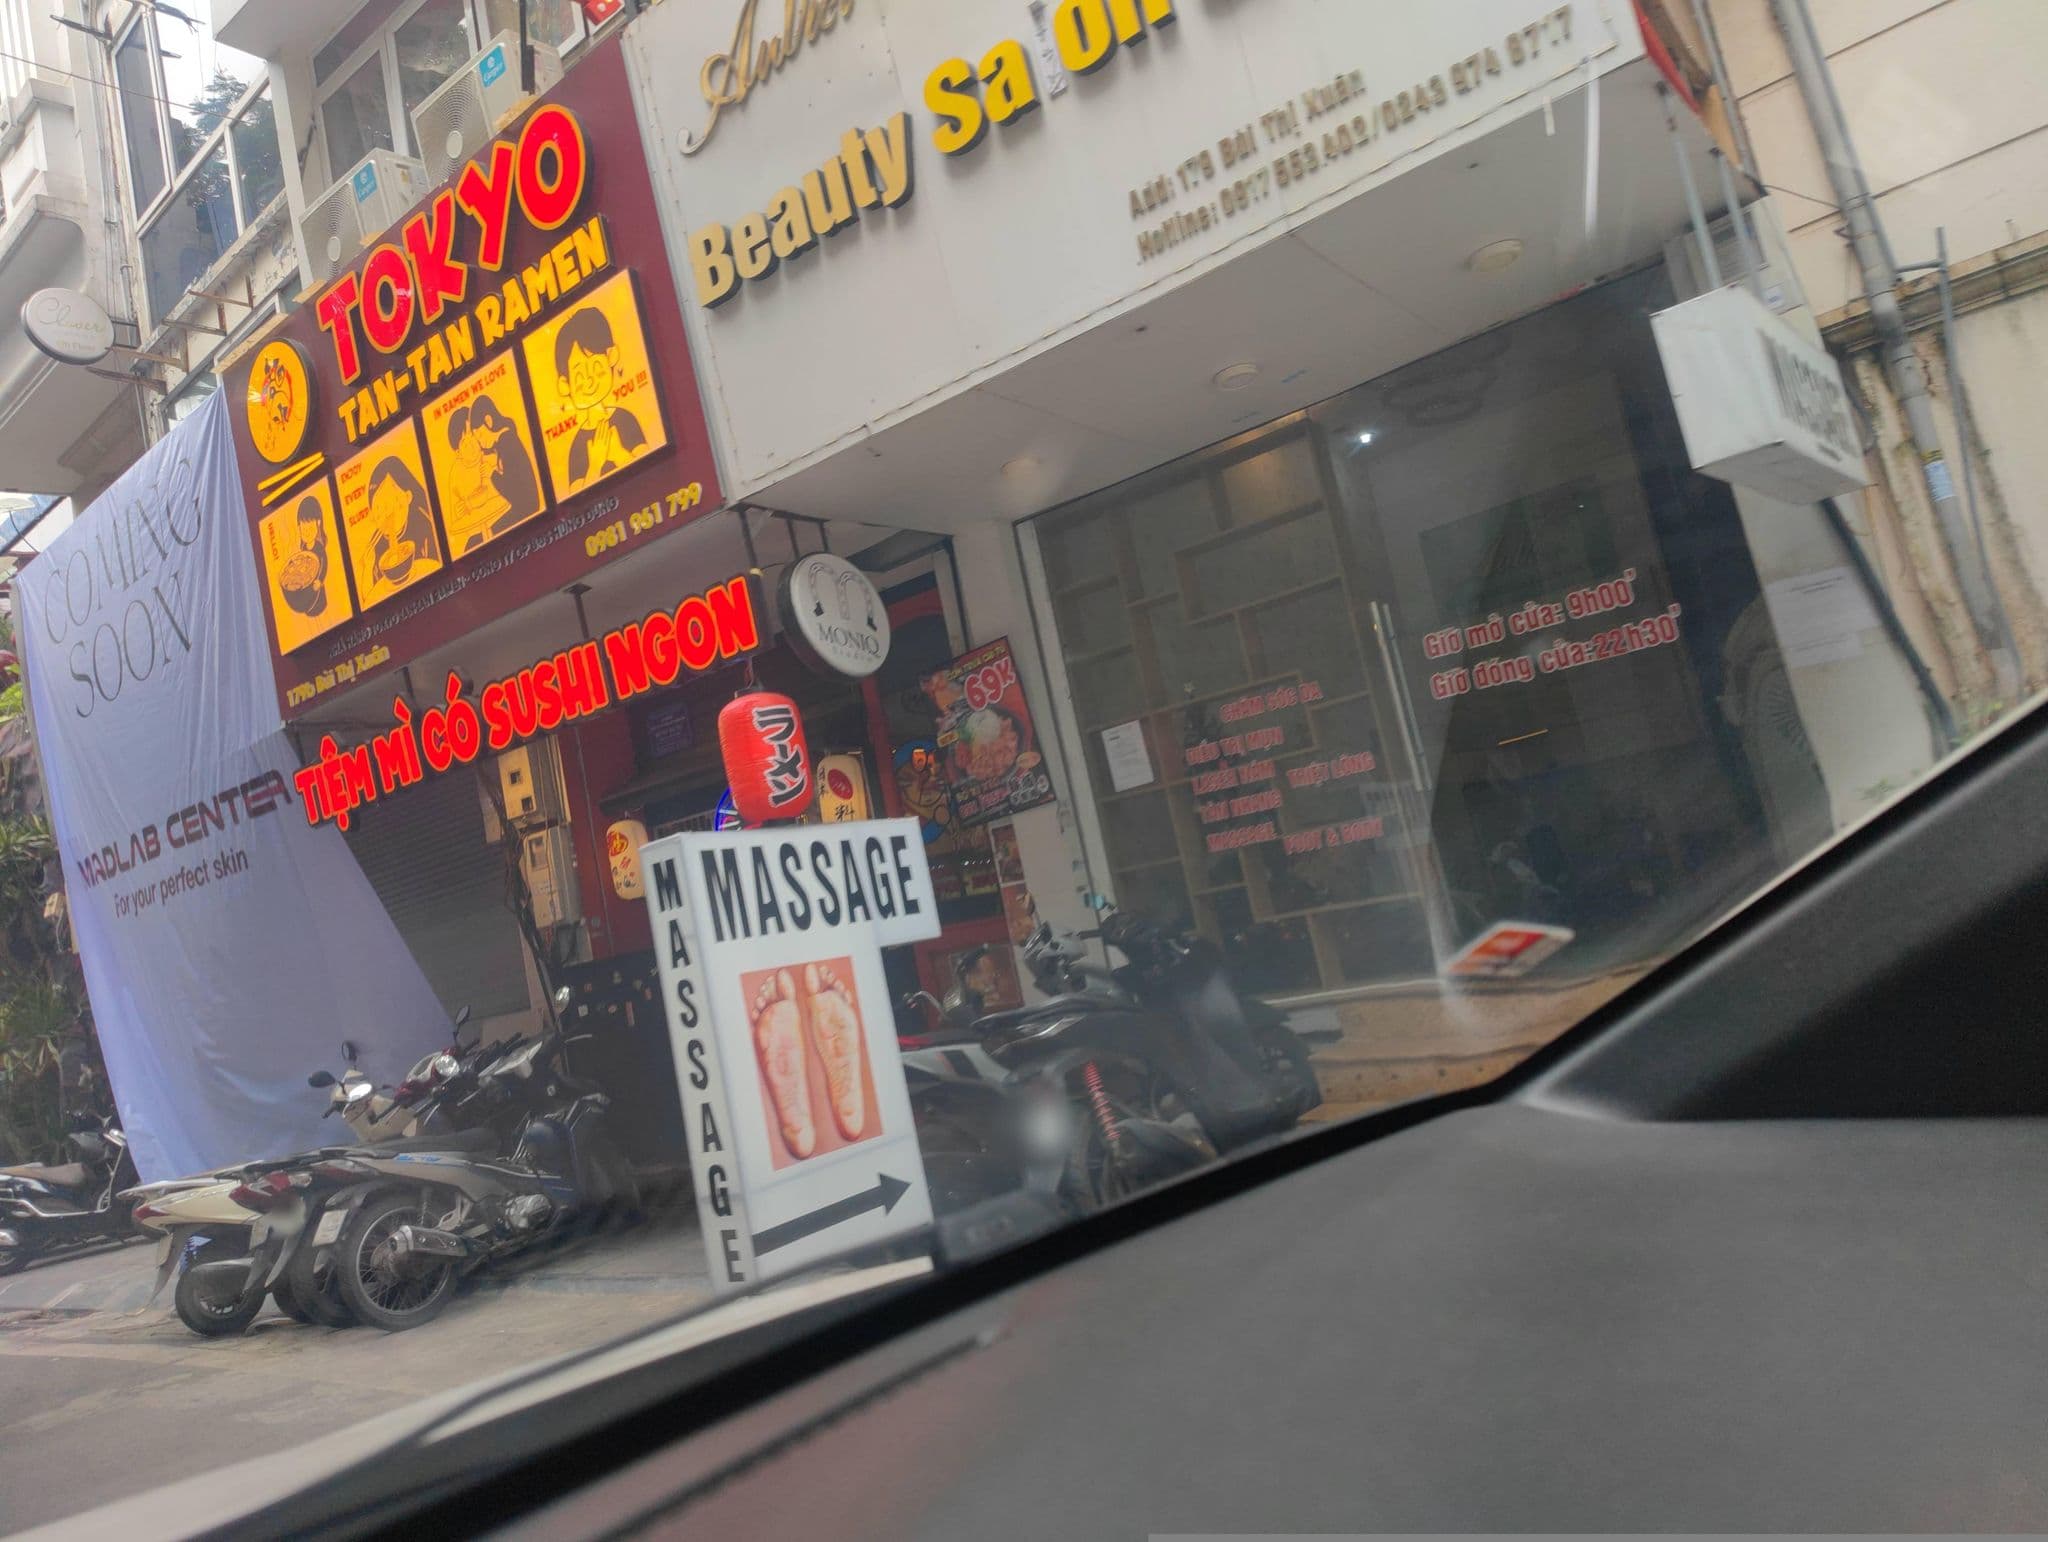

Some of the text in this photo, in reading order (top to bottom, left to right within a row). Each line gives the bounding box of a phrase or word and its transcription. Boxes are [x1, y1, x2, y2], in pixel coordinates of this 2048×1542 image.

[687, 0, 1175, 308] Beauty Sao
[316, 103, 586, 386] TOKYO
[338, 216, 609, 443] TAN-TAN RAMEN
[484, 363, 507, 385] LOVE
[545, 415, 578, 441] THANK
[613, 382, 635, 401] YOU
[44, 457, 202, 645] COMING
[629, 502, 664, 535] 961
[666, 482, 703, 518] 799
[69, 571, 192, 719] SOON
[964, 656, 1016, 712] 69K
[1472, 655, 1535, 690] đóng
[294, 735, 376, 831] TIỆM
[372, 697, 423, 793] MÌ
[421, 672, 481, 772] CÓ
[481, 641, 609, 750] SUSHI
[604, 576, 759, 700] NGON
[752, 704, 807, 808] ラーメン
[77, 769, 293, 889] MADLAB CENTER
[132, 884, 156, 917] your
[160, 858, 210, 907] perfect
[213, 847, 249, 880] skin
[701, 835, 921, 943] MASSAGE
[652, 858, 745, 1284] MASSAGE
